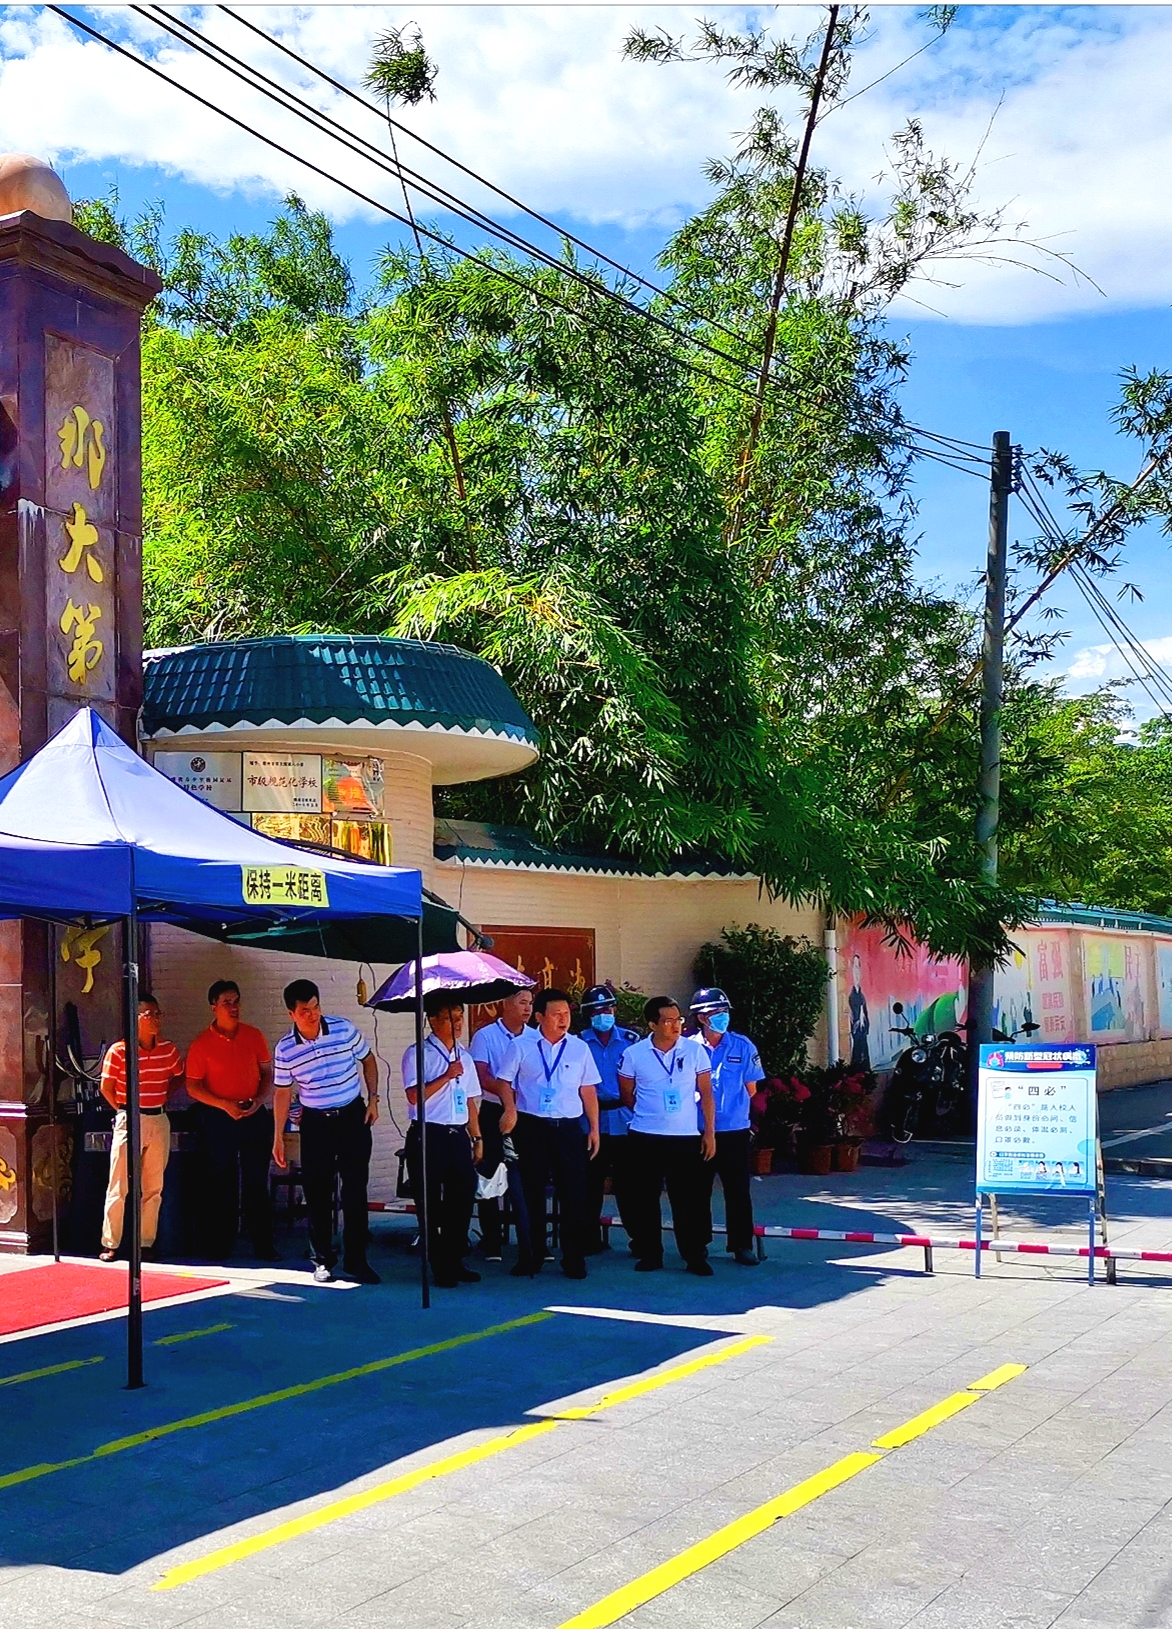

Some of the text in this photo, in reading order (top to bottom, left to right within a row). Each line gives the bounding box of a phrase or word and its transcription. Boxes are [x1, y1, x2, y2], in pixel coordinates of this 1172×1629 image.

[246, 868, 322, 902] 保持一米距离
